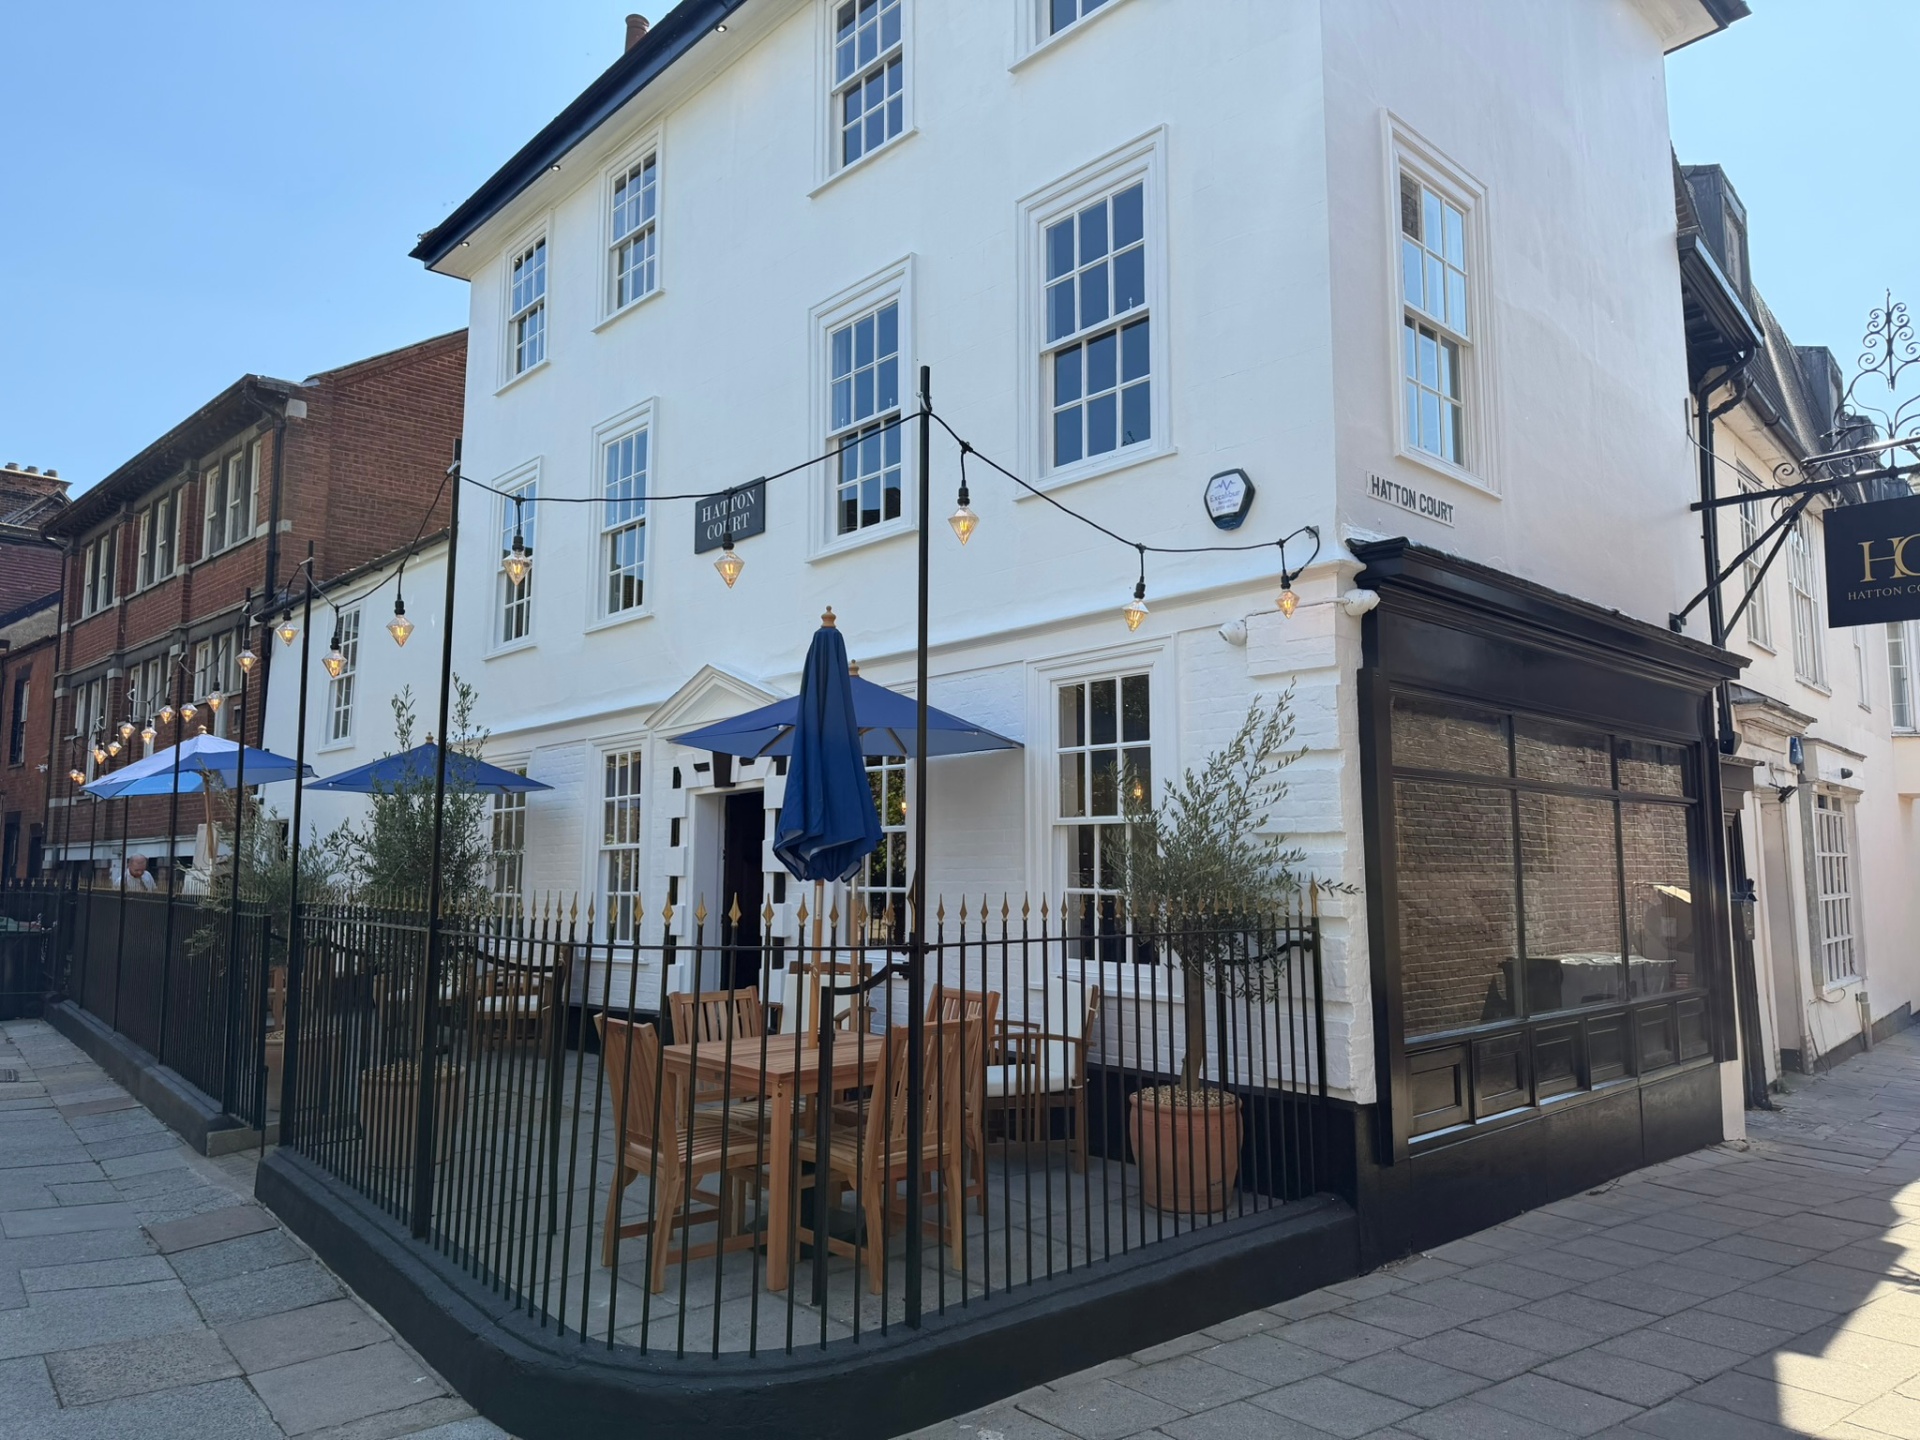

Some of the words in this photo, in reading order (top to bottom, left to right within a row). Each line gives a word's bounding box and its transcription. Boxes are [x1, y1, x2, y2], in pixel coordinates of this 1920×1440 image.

[701, 489, 757, 523] HATTON
[1371, 474, 1416, 510] HATTON
[1419, 493, 1454, 523] COURT
[1848, 586, 1902, 600] HATTON
